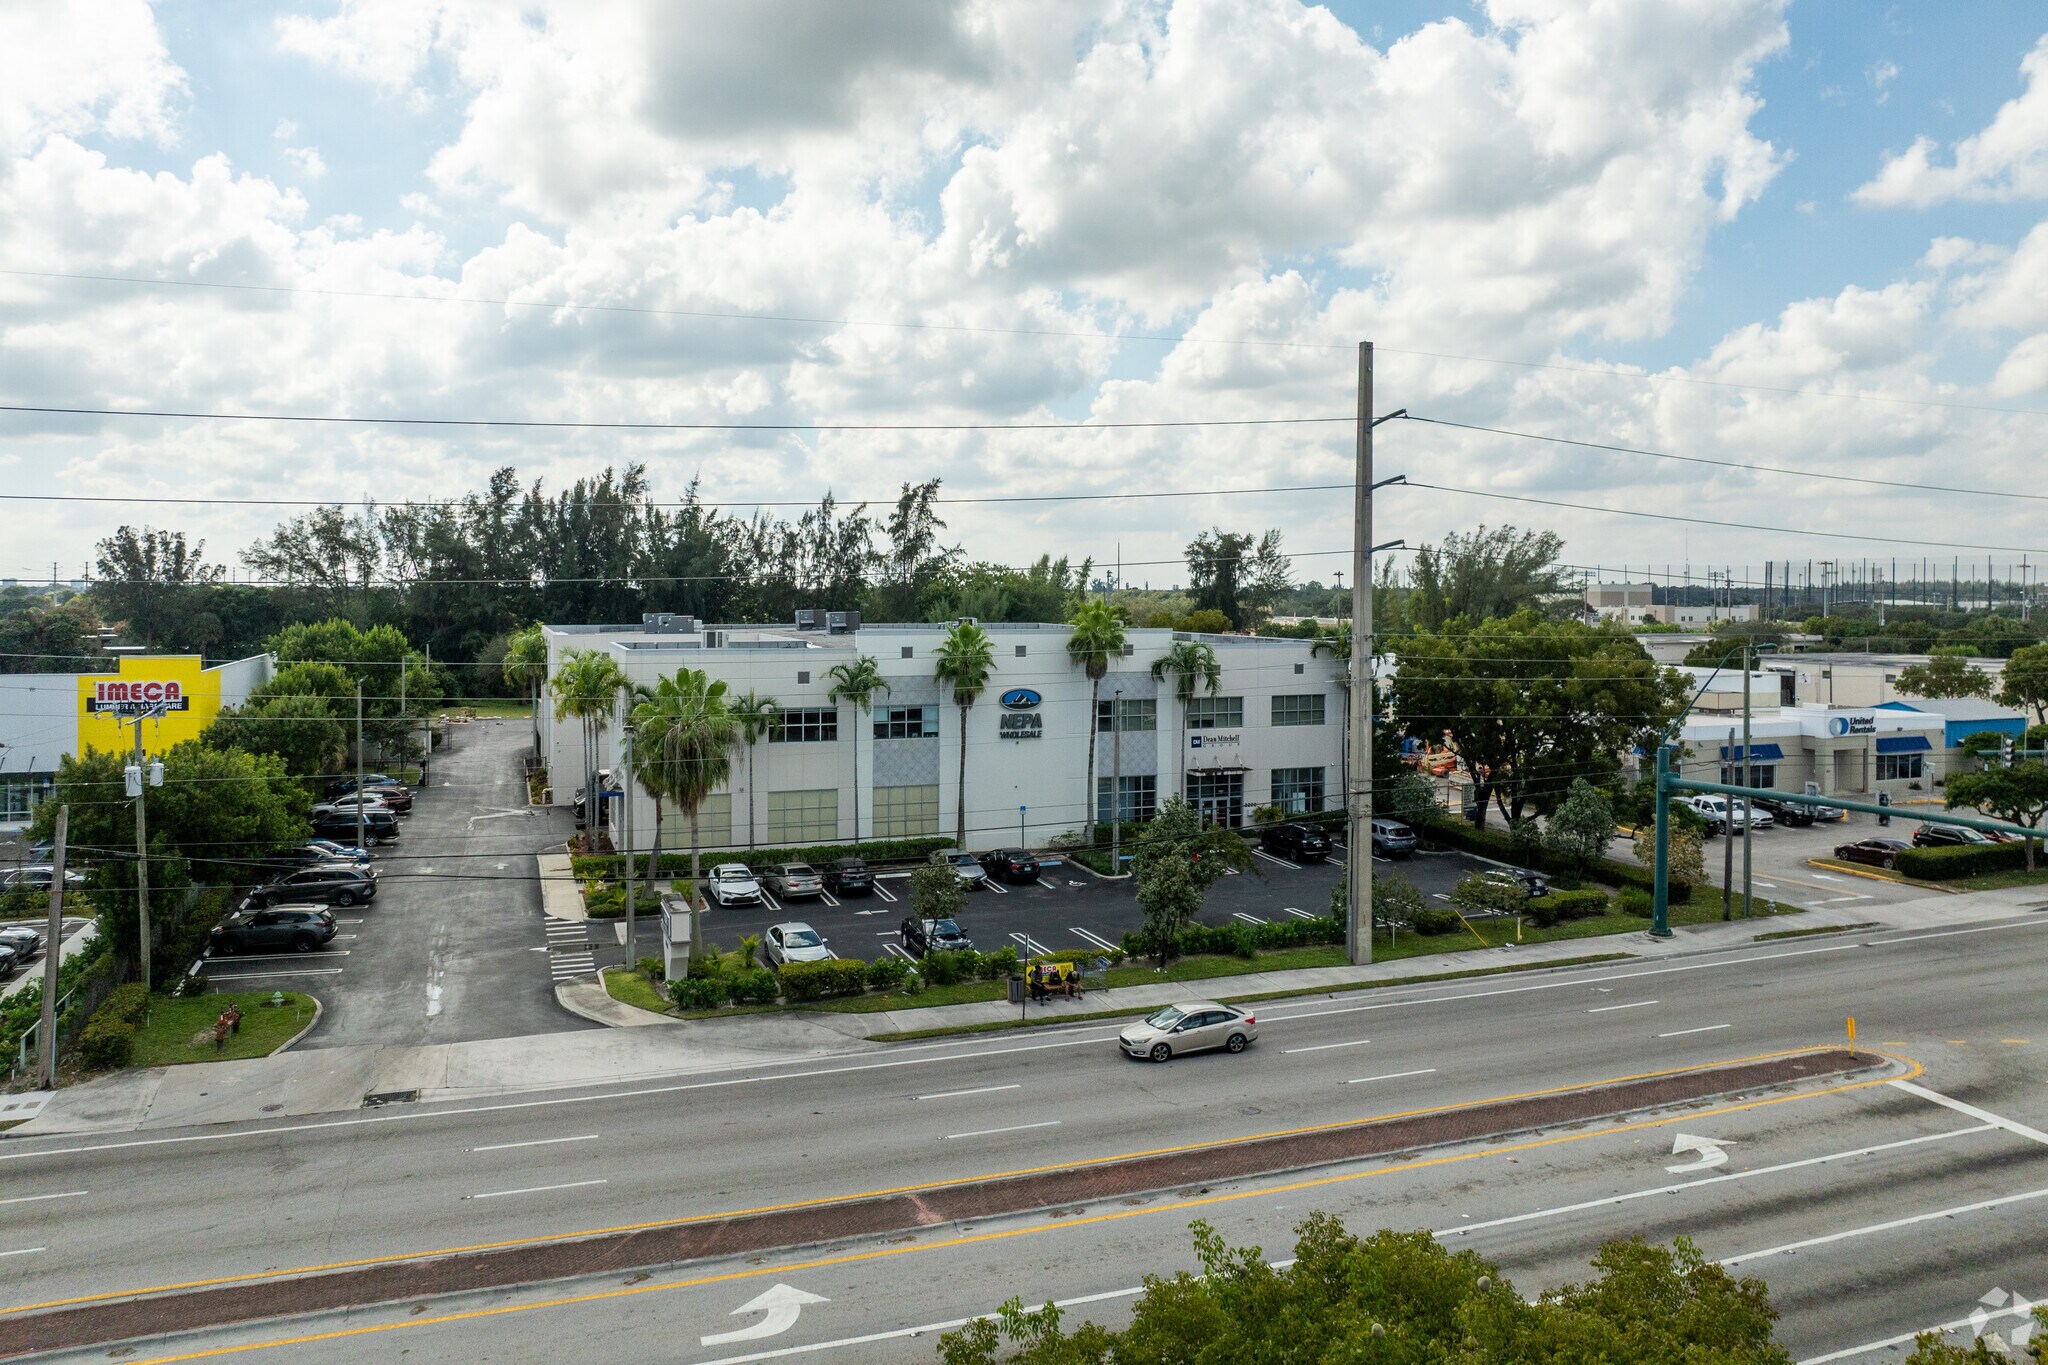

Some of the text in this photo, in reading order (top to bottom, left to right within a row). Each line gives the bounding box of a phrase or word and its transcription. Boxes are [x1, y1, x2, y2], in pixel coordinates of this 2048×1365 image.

[98, 682, 179, 701] IMECA
[1000, 713, 1042, 729] NEPA
[1850, 716, 1874, 725] United
[1850, 725, 1876, 733] Rentals
[1000, 730, 1042, 739] WHOLESALE
[1217, 734, 1240, 742] Mitchell
